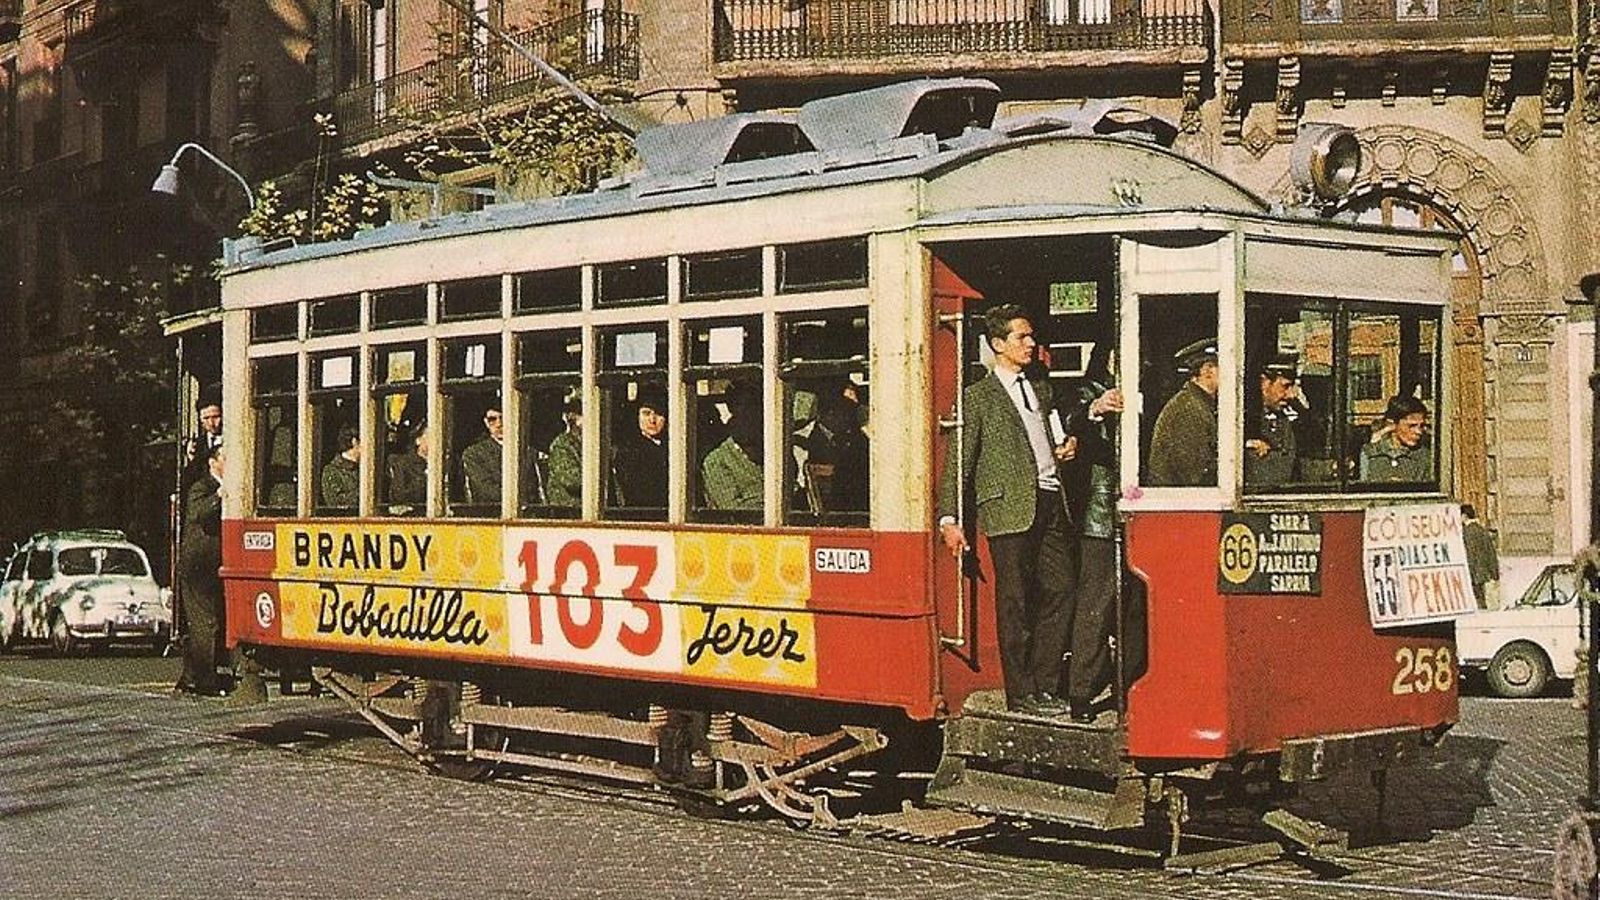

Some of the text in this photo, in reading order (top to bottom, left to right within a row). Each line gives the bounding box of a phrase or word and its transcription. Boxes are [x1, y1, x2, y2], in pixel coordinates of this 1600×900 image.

[1368, 513, 1460, 541] COLISEUM
[294, 532, 432, 571] BRANDY
[817, 551, 867, 570] SALIDA
[1224, 534, 1252, 570] 66
[1259, 554, 1318, 573] PARALELO
[1398, 543, 1451, 566] DIAS EN
[518, 539, 664, 657] 103
[1373, 554, 1397, 616] 55
[1408, 570, 1466, 614] PEKIN
[316, 582, 489, 646] Bobadilla
[686, 606, 806, 665] Jerez
[1392, 647, 1453, 695] 258
